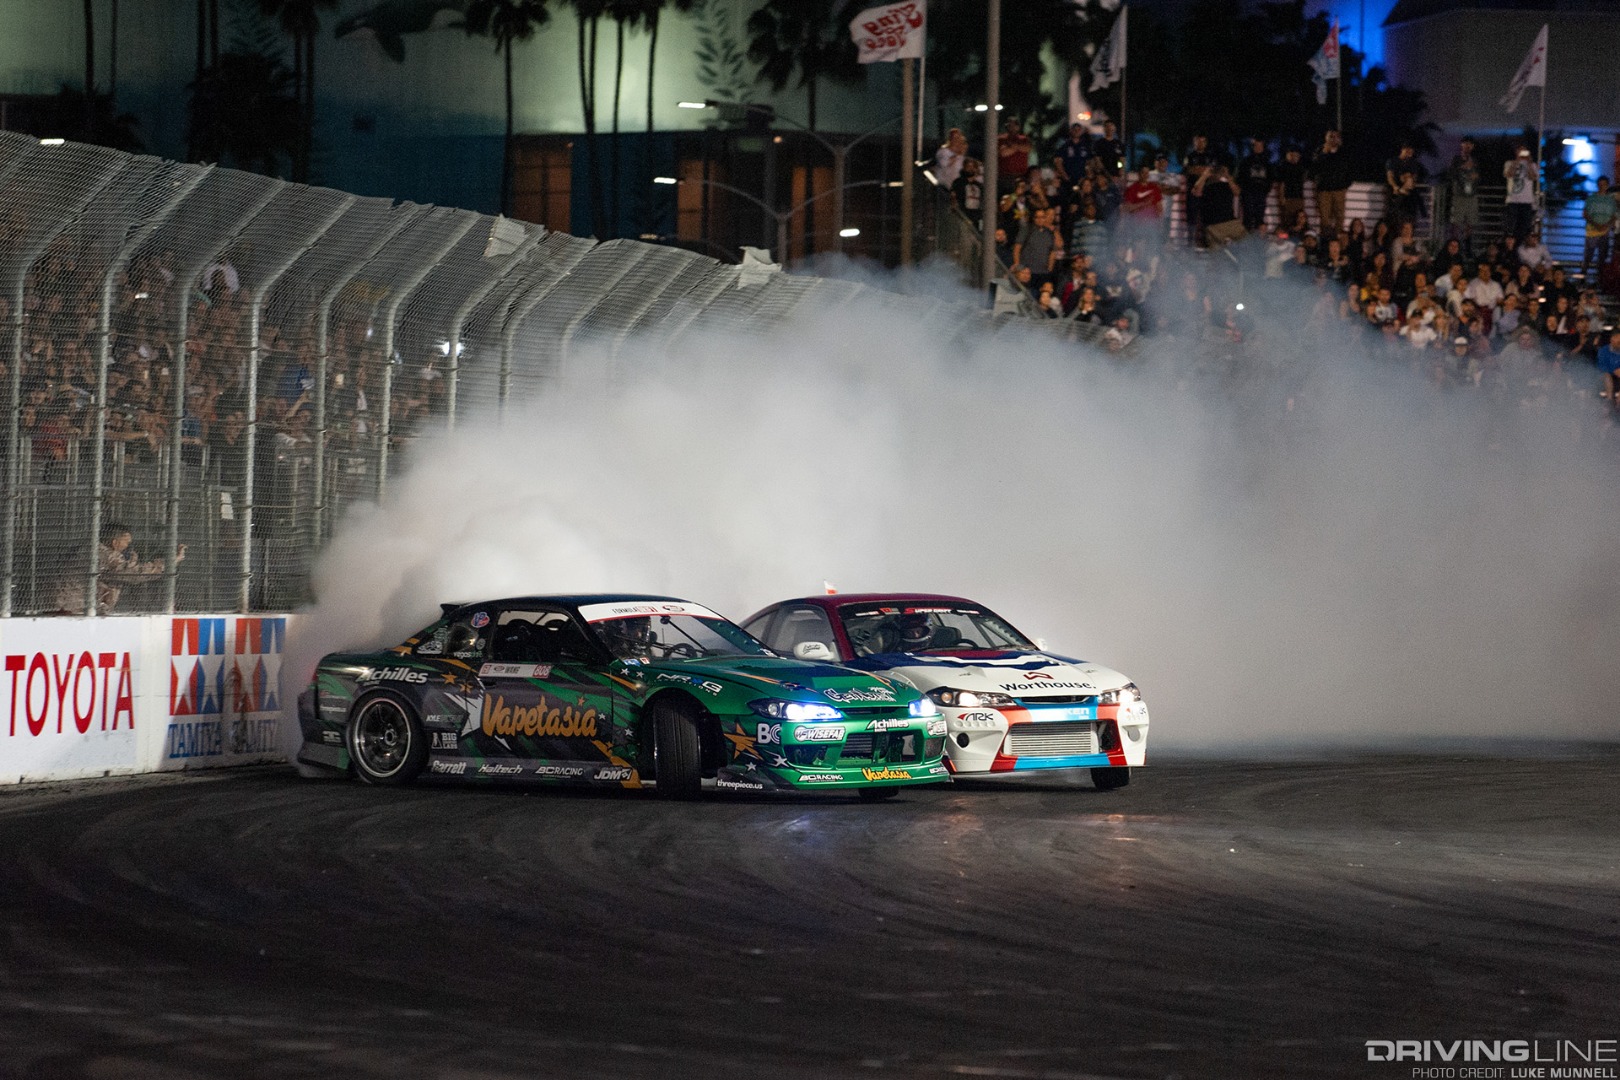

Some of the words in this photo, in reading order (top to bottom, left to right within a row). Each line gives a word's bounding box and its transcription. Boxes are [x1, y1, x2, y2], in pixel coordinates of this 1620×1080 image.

[355, 667, 429, 684] Achilles
[5, 651, 135, 737] TOYOTA
[482, 693, 598, 737] Vapetasia
[867, 719, 909, 730] Achilles
[168, 722, 222, 758] TAMIYA
[442, 732, 457, 741] BIG
[807, 729, 845, 740] WISEFAB
[431, 760, 467, 775] Garrett
[478, 764, 524, 775] Haltech
[717, 778, 763, 790] threepiece.us
